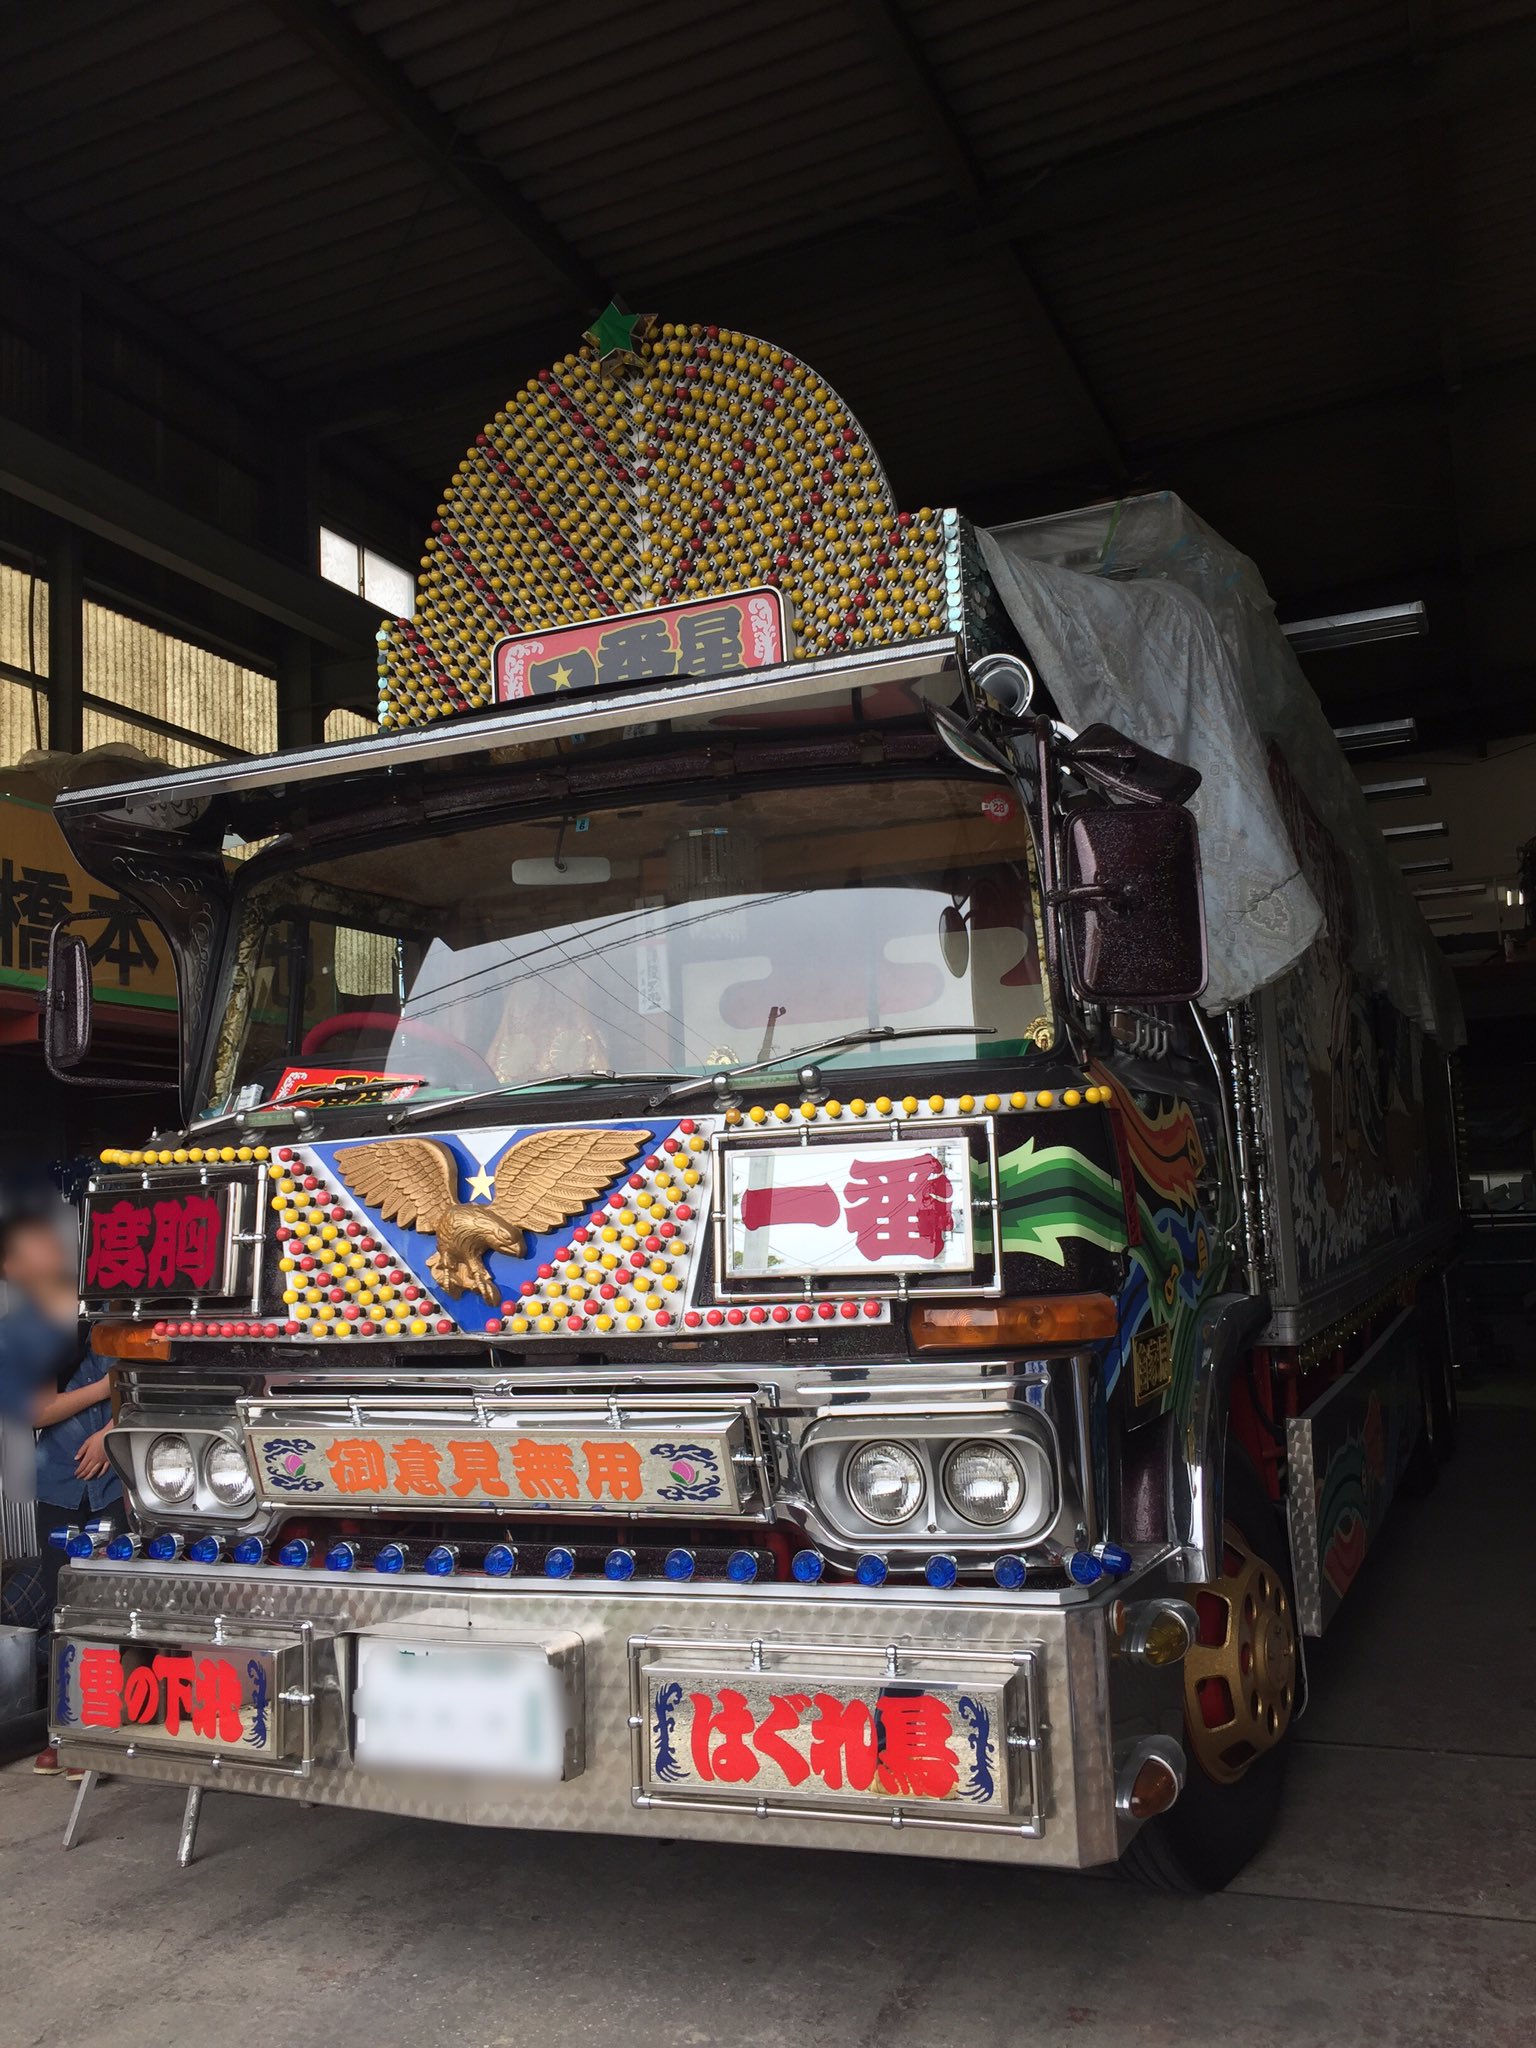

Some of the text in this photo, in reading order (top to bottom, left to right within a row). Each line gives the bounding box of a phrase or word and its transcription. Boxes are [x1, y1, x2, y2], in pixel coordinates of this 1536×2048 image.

[87, 1196, 221, 1290] 度胸
[741, 1153, 954, 1262] 一番
[325, 1438, 643, 1501] 御意見無用
[79, 1647, 244, 1743] 雪の下北
[689, 1688, 960, 1797] はぐれ鳥
